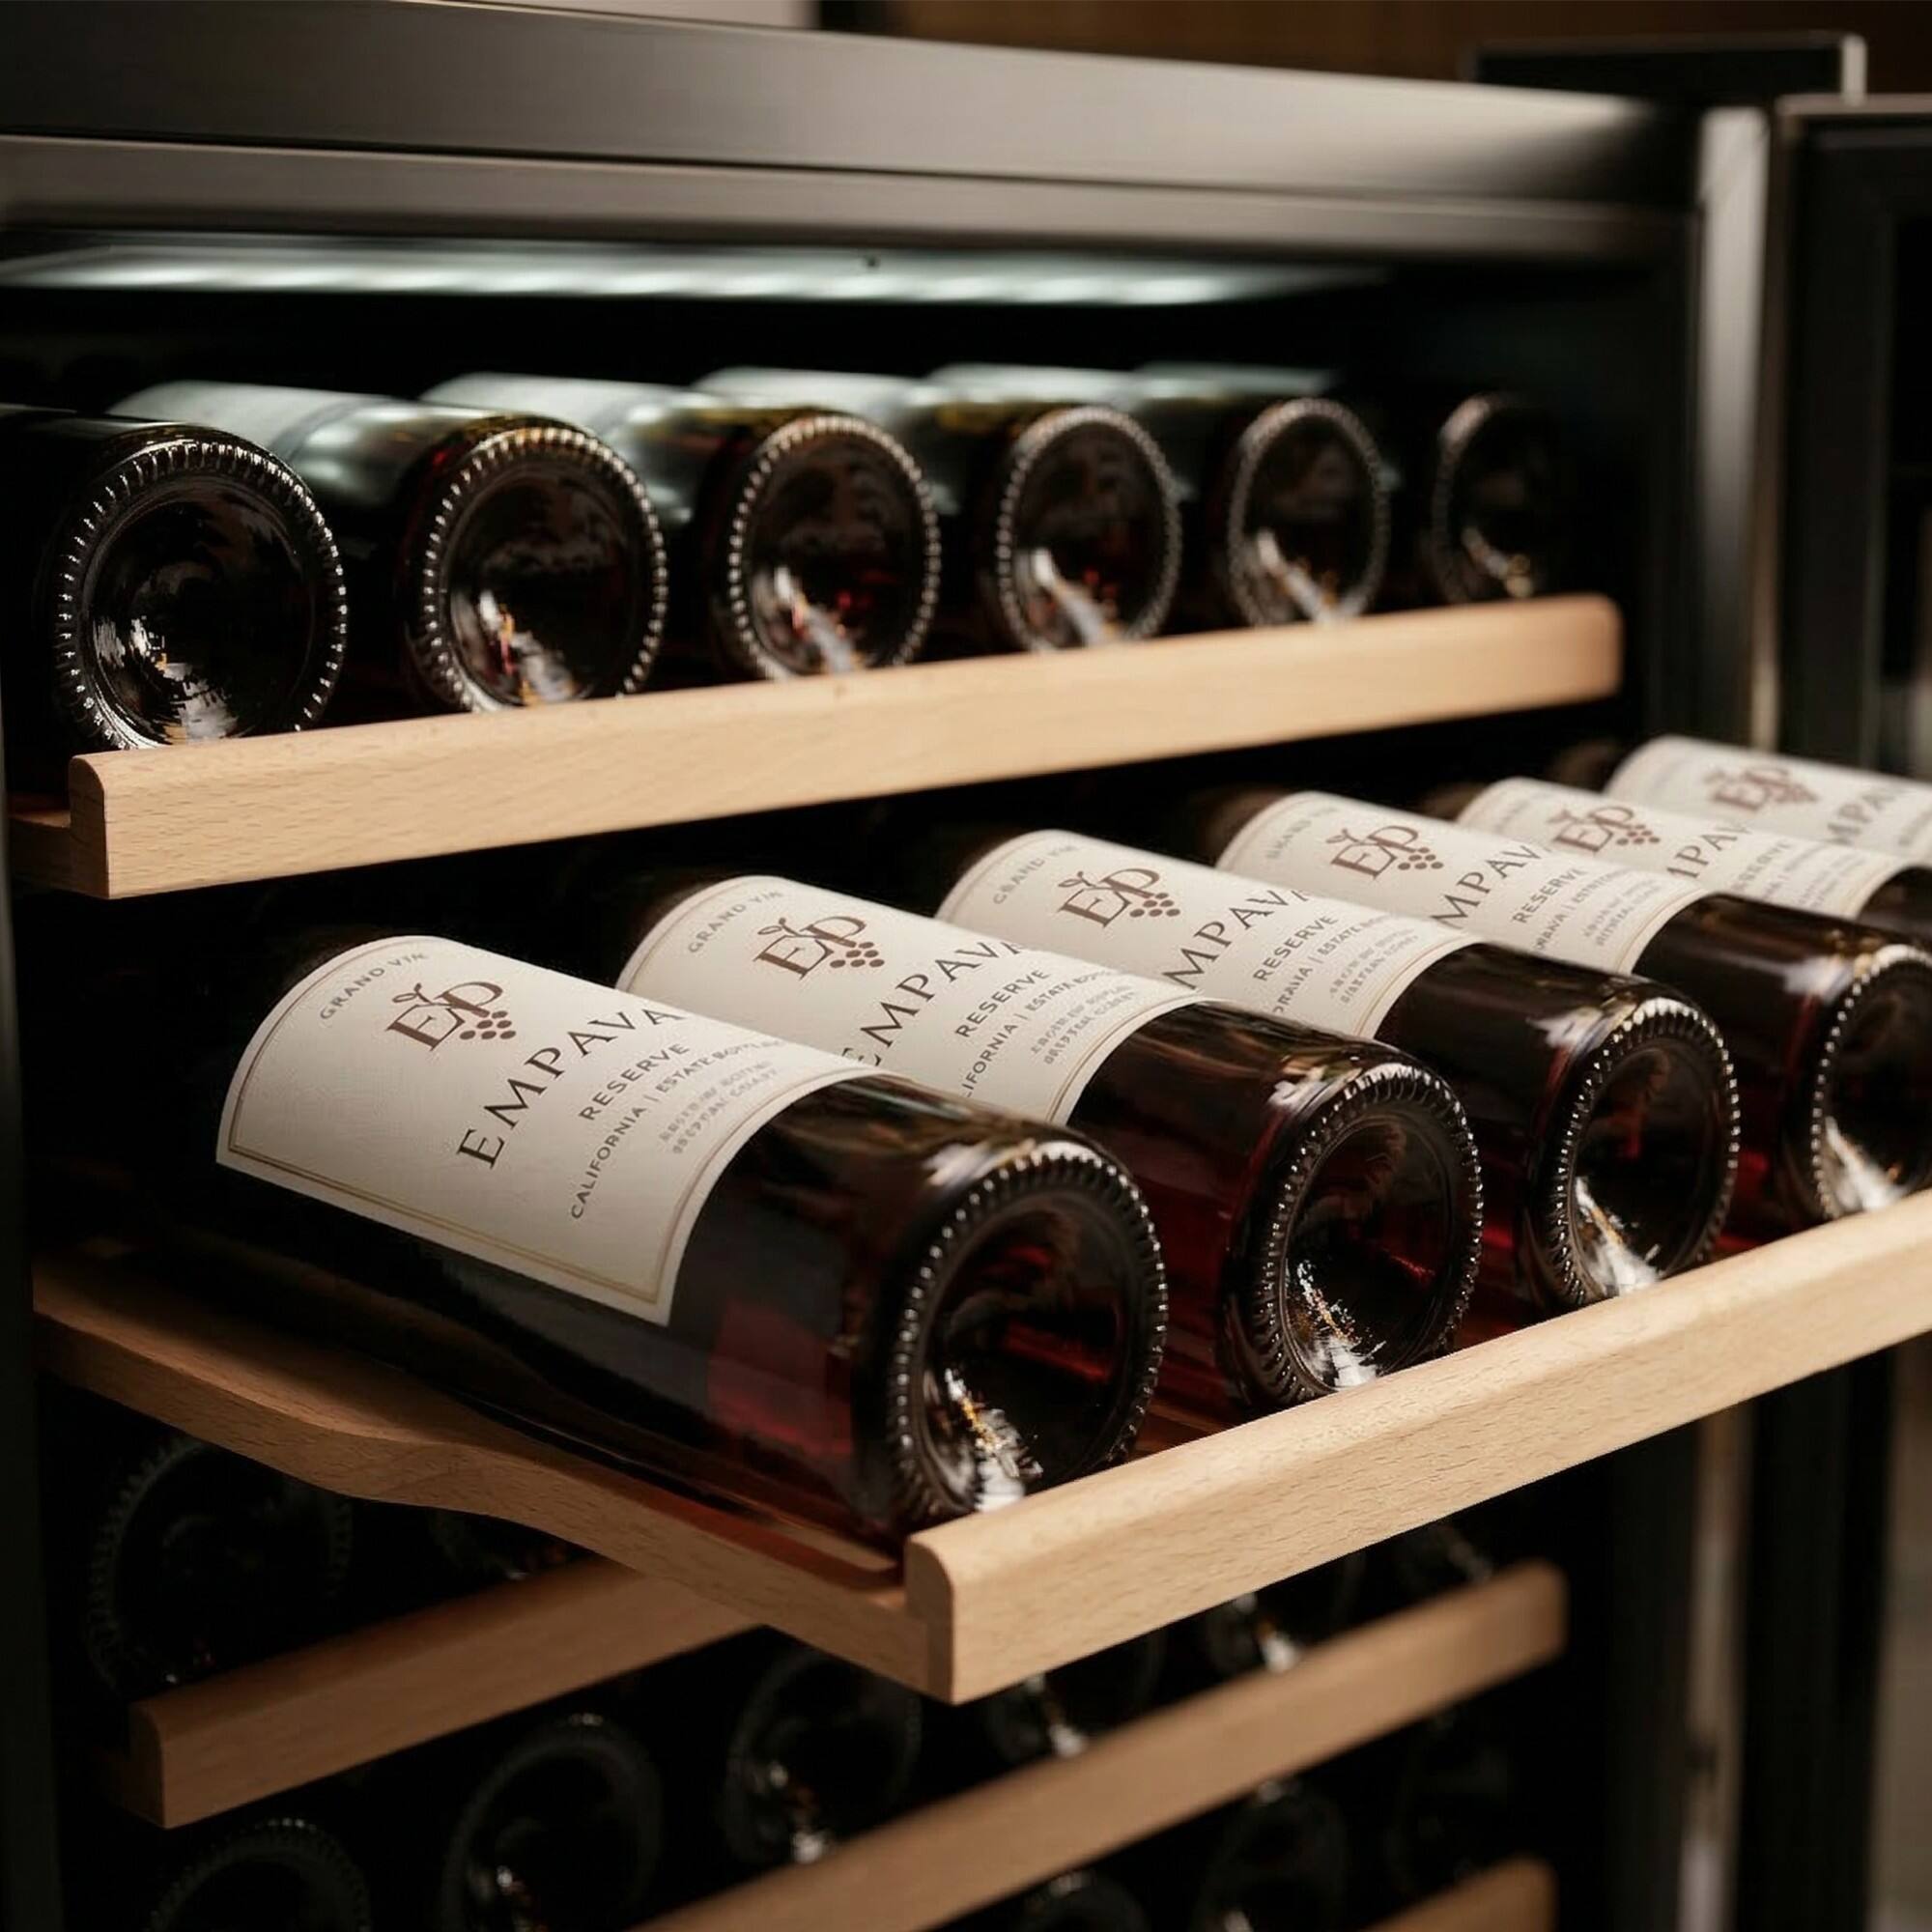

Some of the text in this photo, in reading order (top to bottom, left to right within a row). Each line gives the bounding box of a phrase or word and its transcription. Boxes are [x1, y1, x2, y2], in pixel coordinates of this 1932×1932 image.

[1330, 824, 1420, 880] EP
[1430, 844, 1546, 929] MPAV
[688, 903, 747, 953] GRAND
[1057, 867, 1160, 928] EP
[753, 916, 867, 980] EP
[1161, 890, 1310, 991] MPAV
[1253, 915, 1339, 981] RESERVE
[320, 967, 385, 1020] GRAND
[384, 981, 503, 1052] EP
[954, 969, 1050, 1038] RESERVE
[456, 1009, 689, 1170] EMPAVA
[579, 1043, 690, 1121] RESERVE
[571, 1107, 647, 1219] CALIFORNIA
